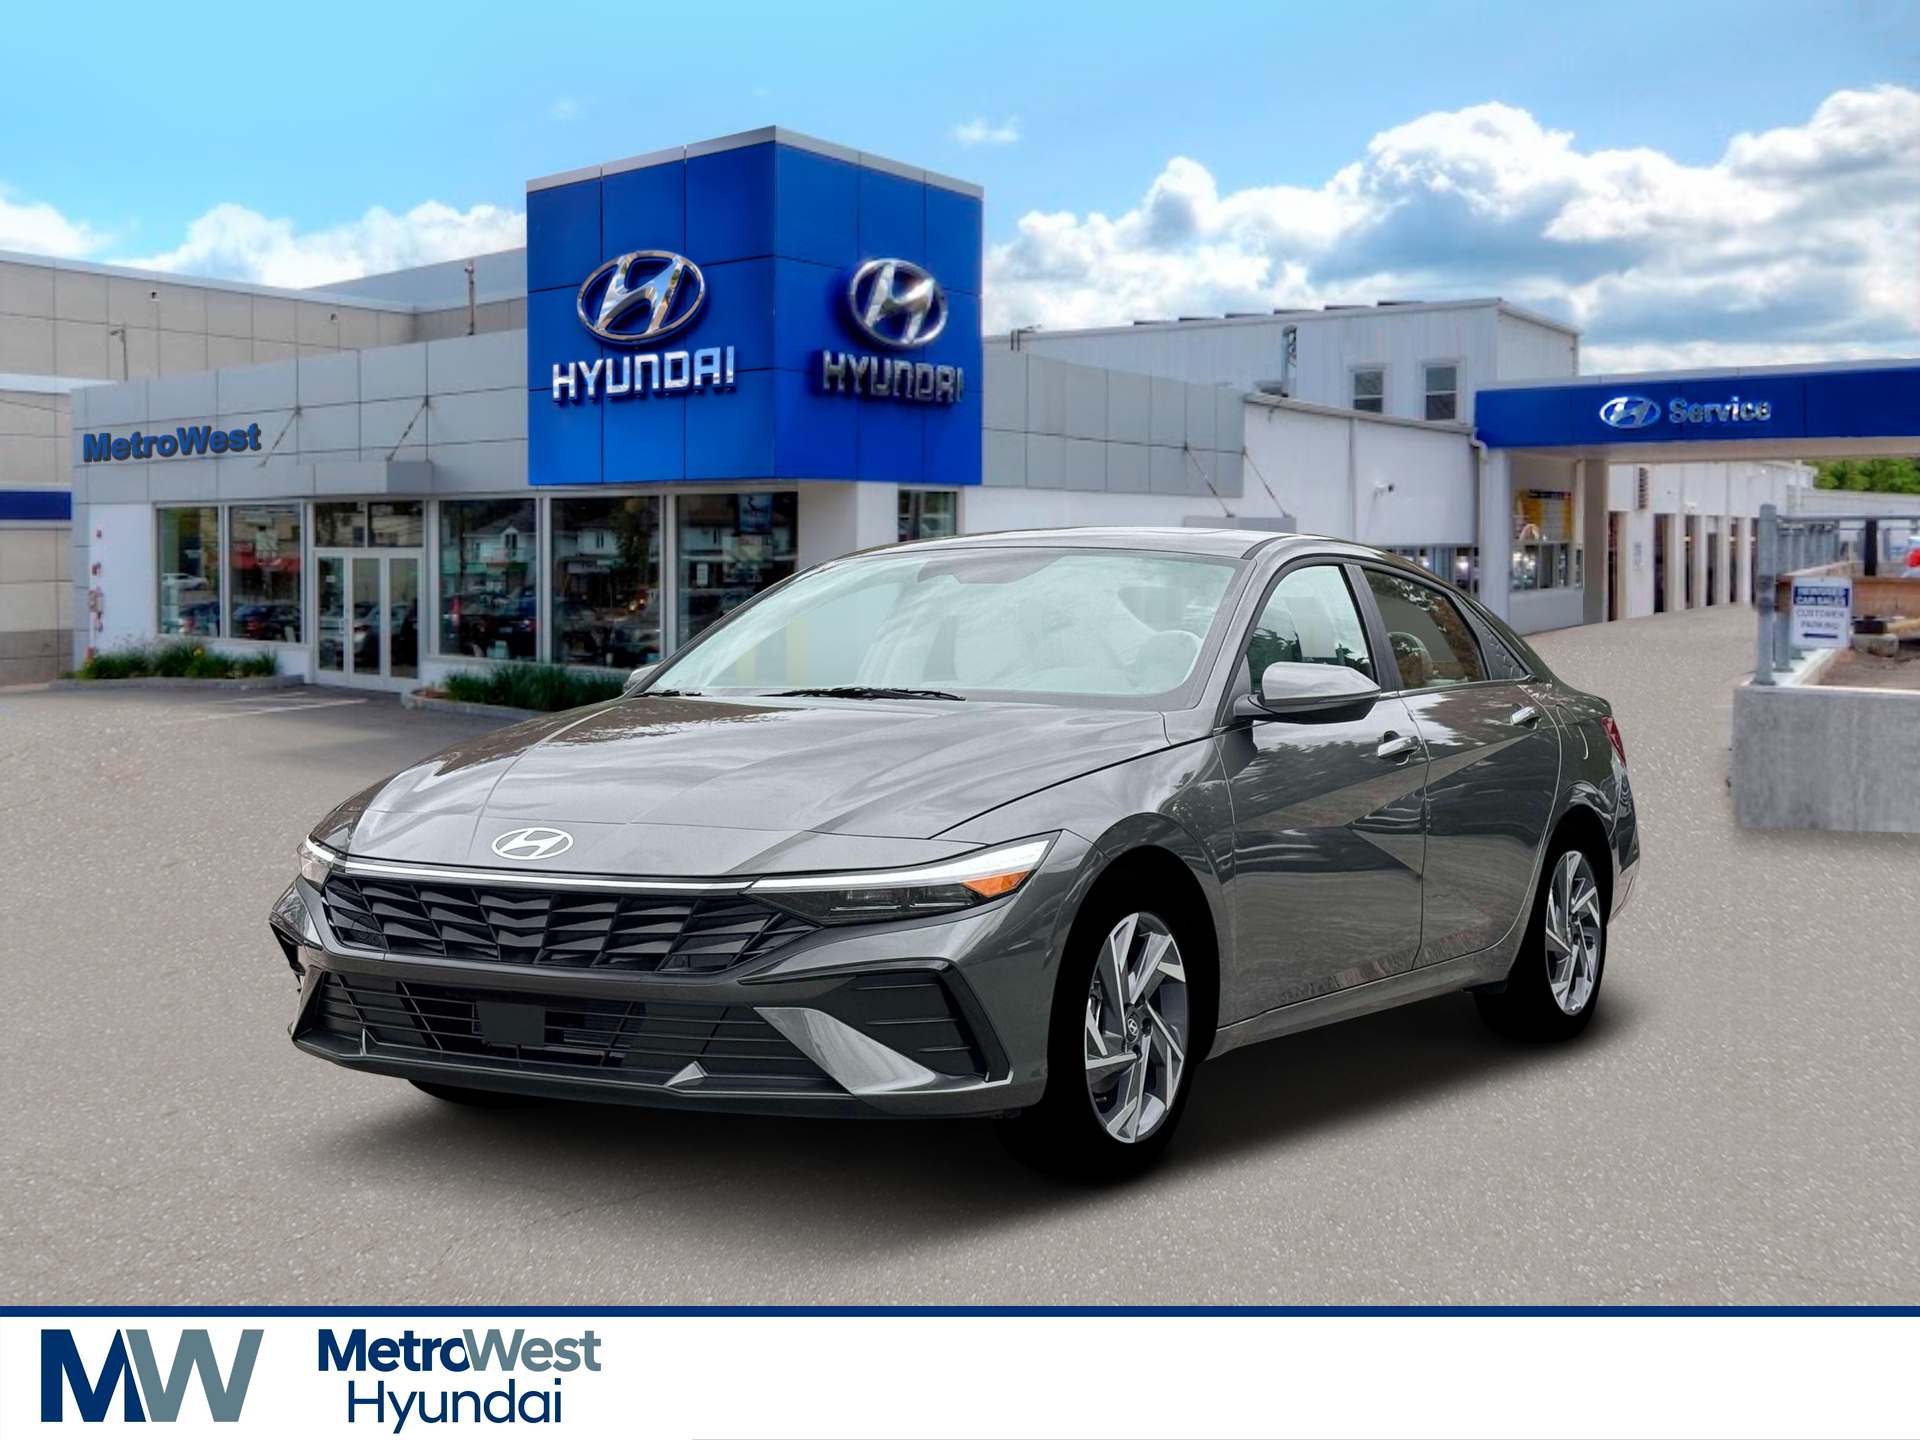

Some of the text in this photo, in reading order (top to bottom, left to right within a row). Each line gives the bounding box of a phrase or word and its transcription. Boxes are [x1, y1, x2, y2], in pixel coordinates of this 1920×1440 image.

[552, 346, 735, 401] HYUNDAI
[822, 350, 963, 403] HYUNDAI
[1669, 396, 1771, 423] Service
[83, 423, 261, 462] MetroWest
[1796, 609, 1845, 618] CUSTOMER
